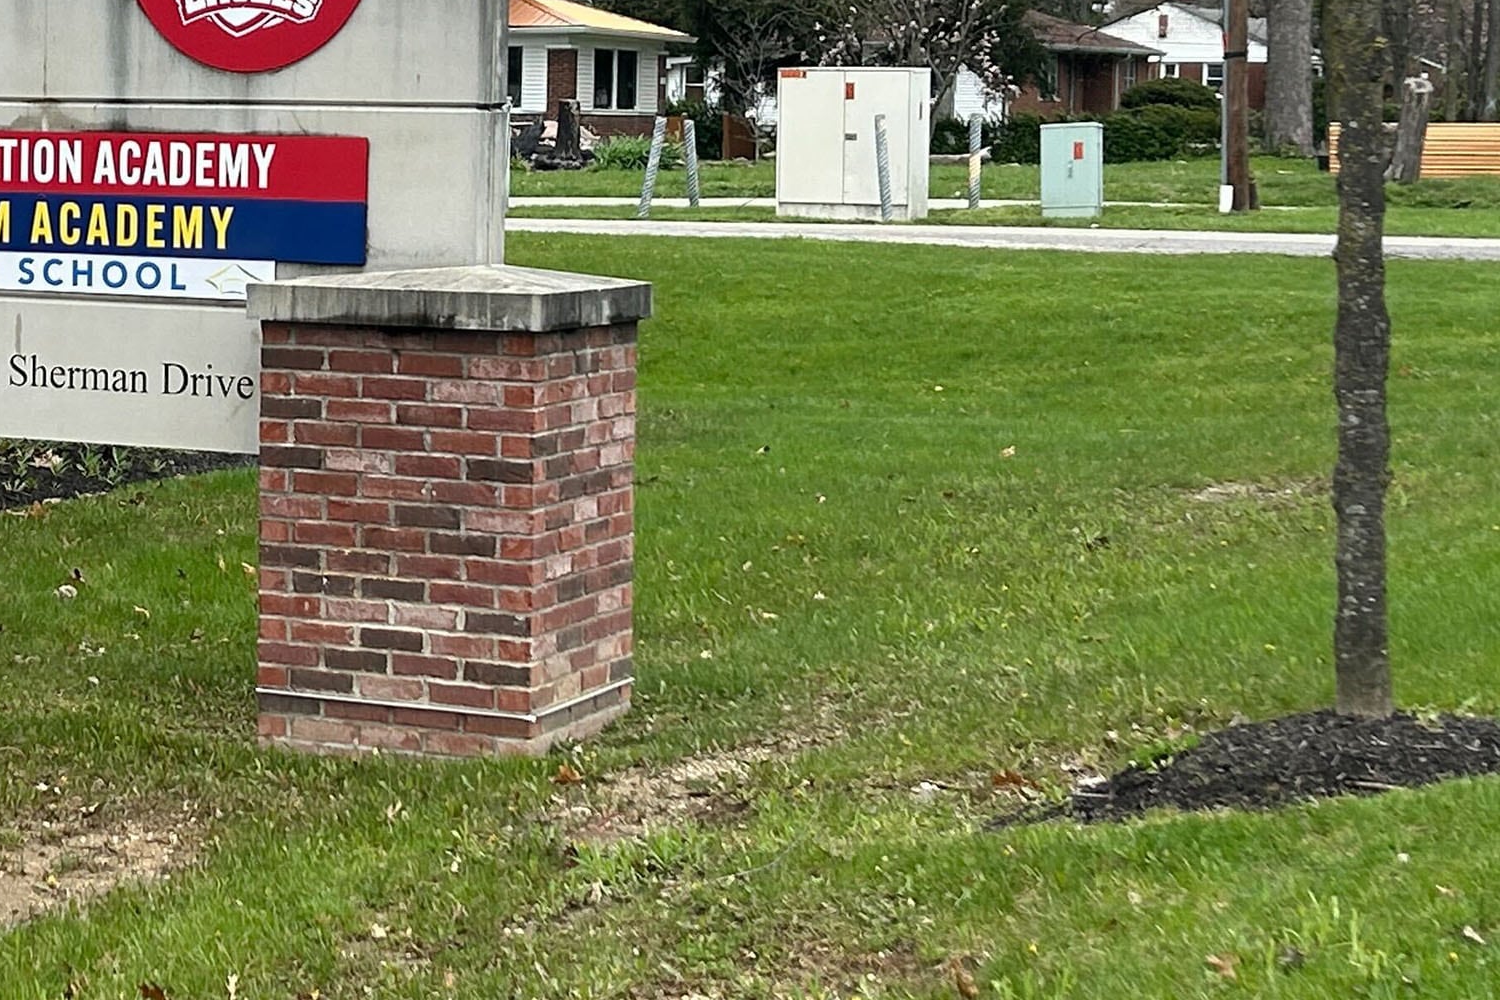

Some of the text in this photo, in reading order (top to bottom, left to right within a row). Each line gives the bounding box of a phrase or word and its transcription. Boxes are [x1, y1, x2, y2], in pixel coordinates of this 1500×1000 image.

[93, 140, 276, 189] ACADEMY
[30, 201, 234, 250] ACADEMY
[18, 257, 187, 291] SCHOOL
[9, 353, 148, 394] Sherman
[162, 362, 255, 400] Drive
